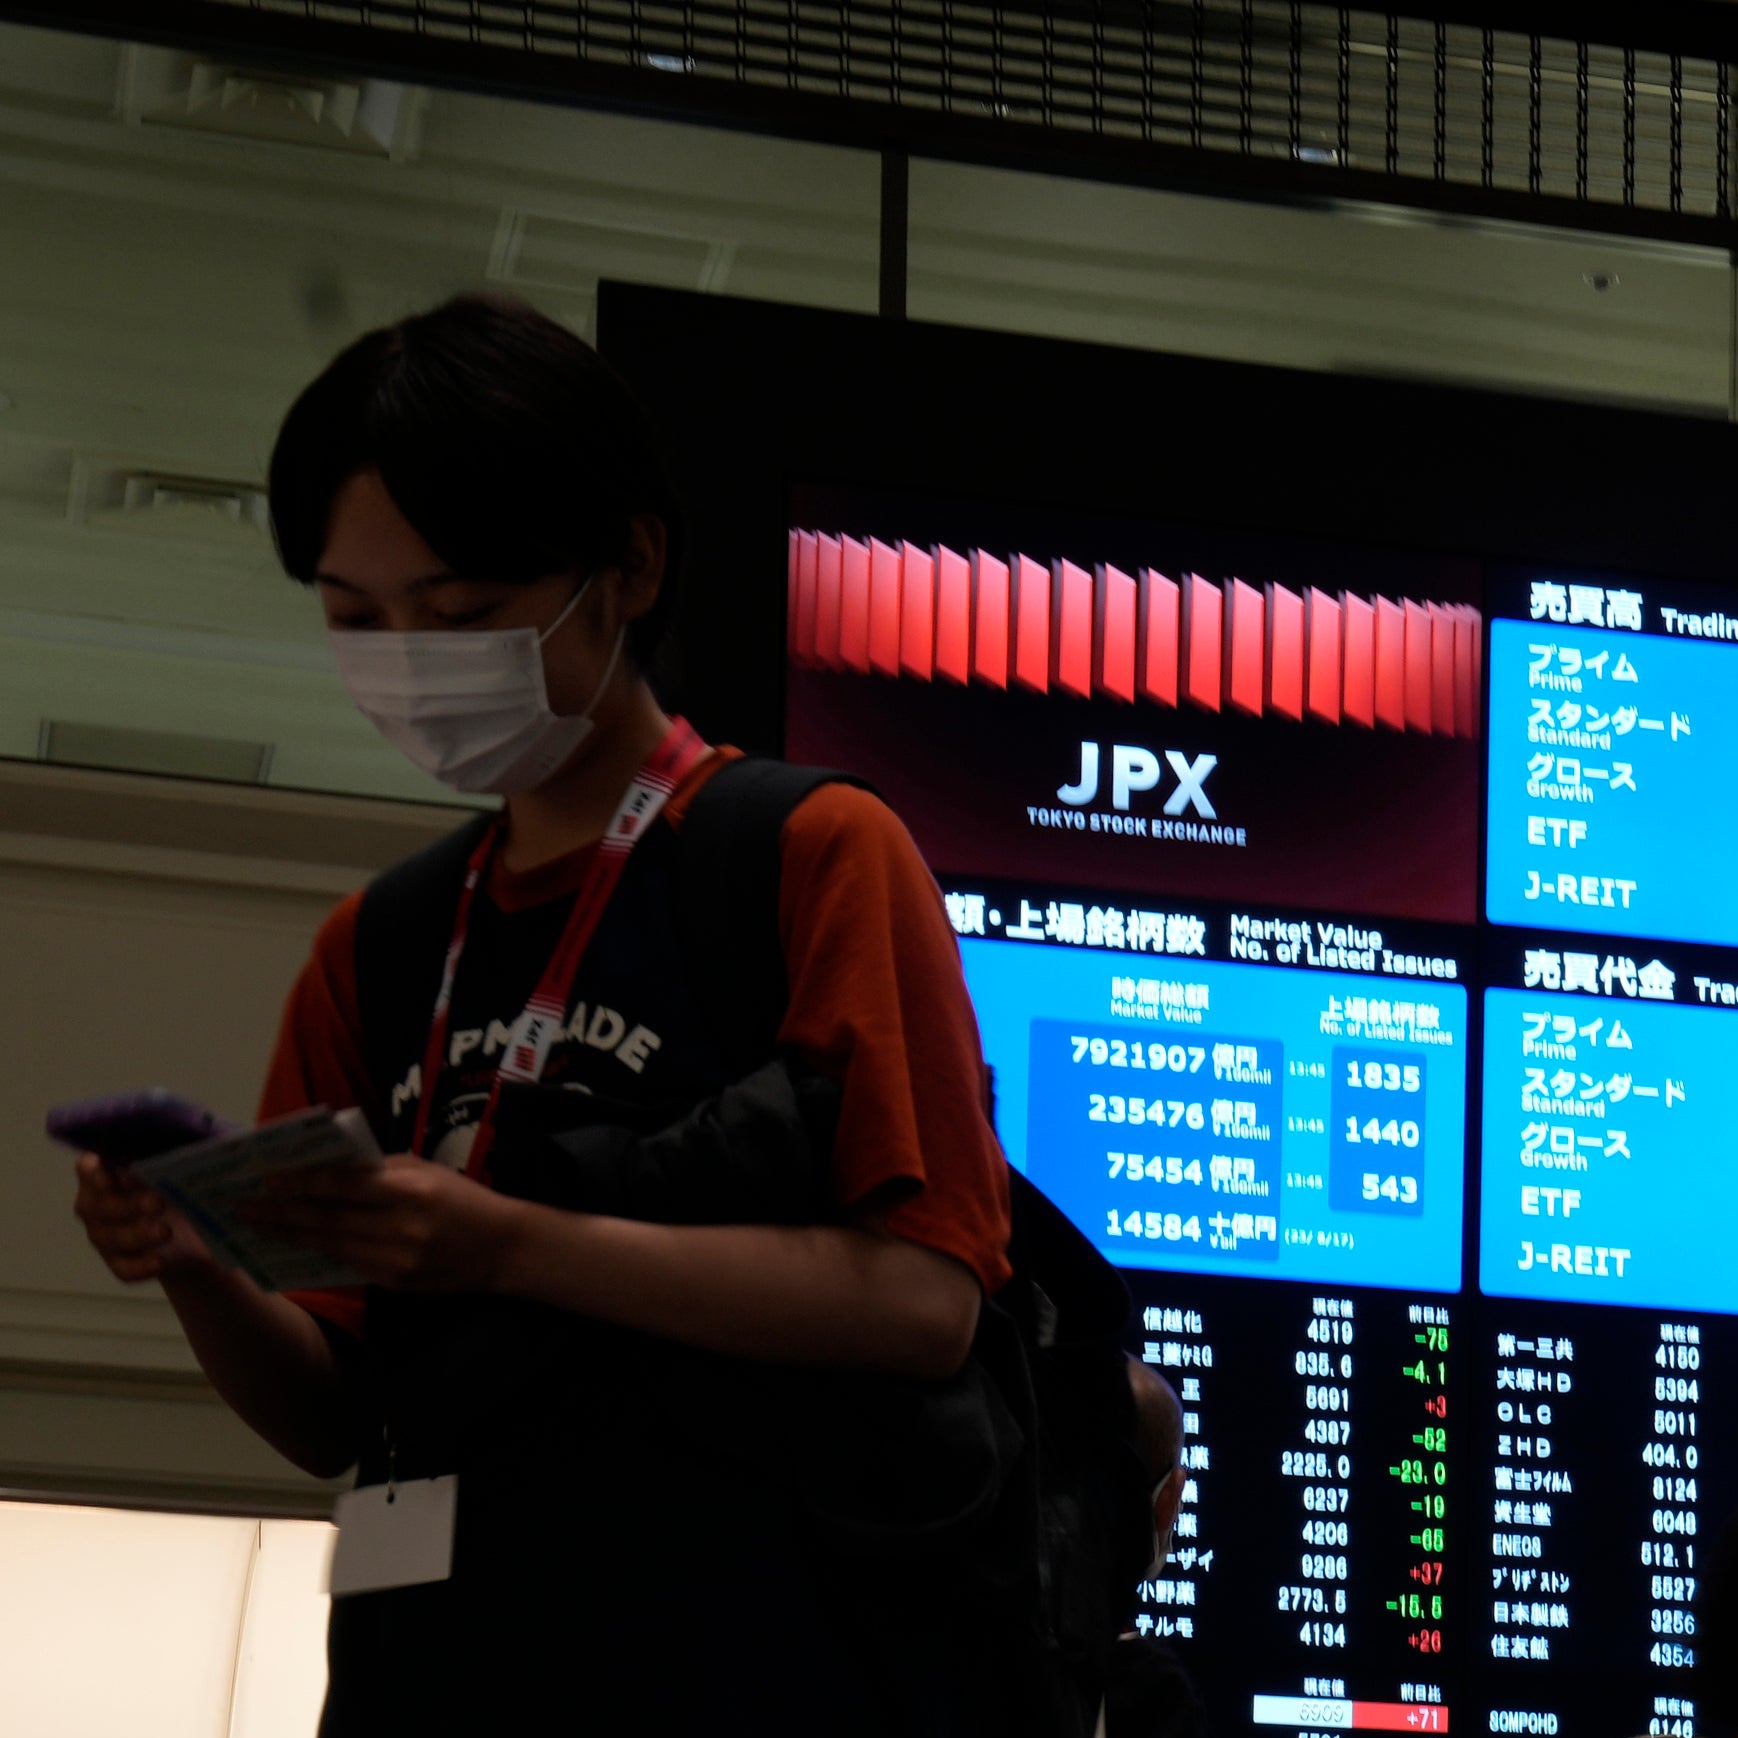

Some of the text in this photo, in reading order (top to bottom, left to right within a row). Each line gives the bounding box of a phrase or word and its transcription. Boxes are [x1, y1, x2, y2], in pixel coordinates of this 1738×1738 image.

[1529, 580, 1643, 631] 売買高
[1528, 642, 1638, 683] プライム
[1528, 667, 1583, 693] Prime
[1528, 698, 1692, 742] スタンダード
[1528, 724, 1612, 751] Standard
[1056, 741, 1218, 820] JPX
[1527, 751, 1637, 792] グロース
[1527, 779, 1594, 804] Growth
[1027, 806, 1247, 847] TOKYO STOCK EXCHANGE
[1527, 814, 1587, 849] ETF
[1524, 870, 1637, 909] J-REIT
[1230, 913, 1312, 943] Market
[1317, 923, 1384, 950] Value
[1230, 935, 1457, 980] No. of Listed Issues
[1524, 949, 1676, 1000] 売買代金
[1522, 1011, 1633, 1050] プライム
[1070, 1035, 1206, 1074] 7921907
[1522, 1037, 1577, 1061] Prime
[1347, 1060, 1421, 1093] 1835
[1521, 1067, 1686, 1108] スタンダード
[1088, 1094, 1205, 1129] 235476
[1521, 1093, 1606, 1119] Standard
[1345, 1116, 1420, 1148] 1440
[1520, 1121, 1631, 1159] グロース
[1107, 1152, 1203, 1186] 75454
[1520, 1148, 1588, 1171] Growth
[1362, 1173, 1418, 1204] 543
[1521, 1185, 1581, 1218] ETF
[1106, 1208, 1201, 1242] 14584
[1517, 1240, 1632, 1278] J-REIT
[1493, 1533, 1542, 1559] ENEOS
[1134, 1617, 1195, 1639] テルモ
[1494, 1601, 1569, 1629] 日本製鉄
[1299, 1621, 1347, 1649] 4134
[1298, 1701, 1439, 1731] 6909 +71
